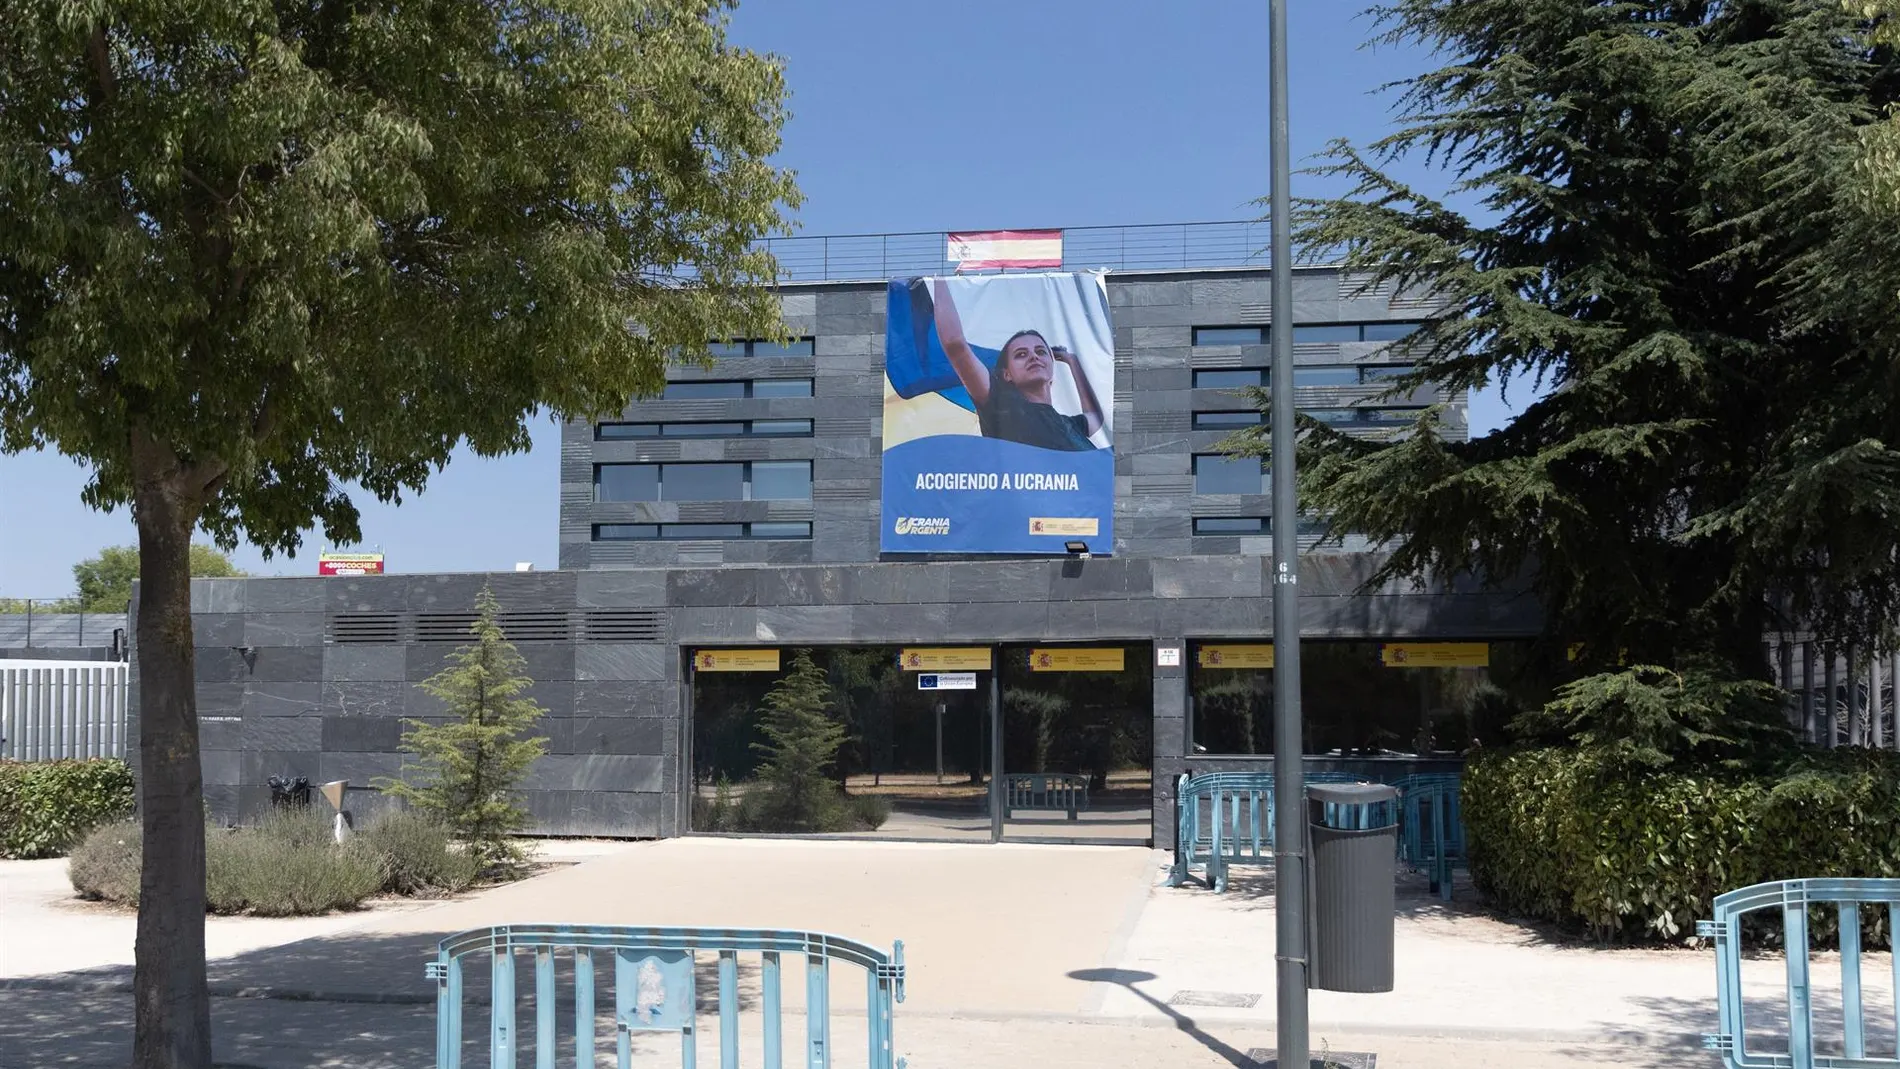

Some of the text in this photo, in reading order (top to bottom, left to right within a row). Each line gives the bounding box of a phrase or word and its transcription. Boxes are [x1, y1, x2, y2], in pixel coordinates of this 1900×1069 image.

[915, 473, 1079, 491] ACOGIENDO A UCRANIA
[1279, 562, 1288, 572] 6
